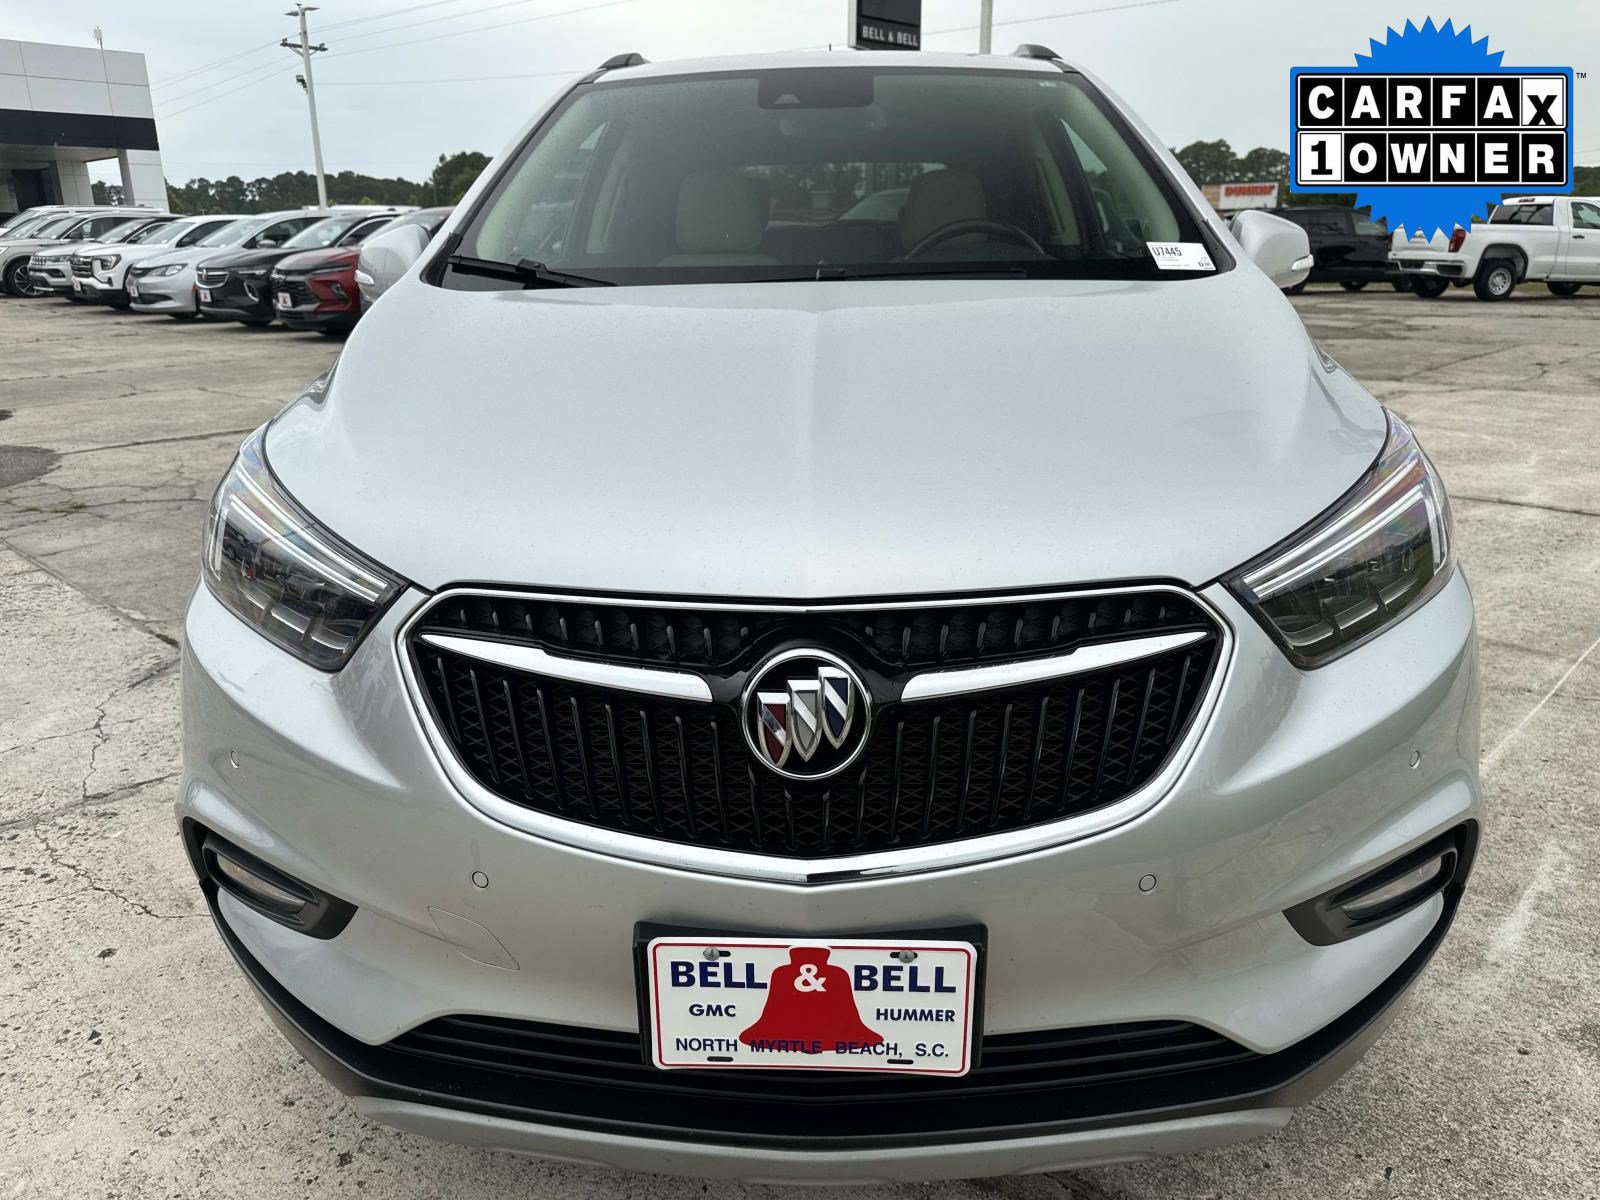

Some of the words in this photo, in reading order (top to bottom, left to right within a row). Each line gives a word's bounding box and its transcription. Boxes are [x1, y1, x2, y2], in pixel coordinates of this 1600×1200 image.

[862, 25, 884, 40] BELL
[896, 31, 918, 46] BELL
[671, 961, 768, 989] BELL
[794, 963, 827, 993] &
[853, 965, 956, 993] BELL
[689, 1004, 736, 1017] GMC
[876, 1008, 955, 1022] HUMMER
[676, 1037, 738, 1052] NORTH
[750, 1039, 823, 1054] MYRTLE
[835, 1041, 902, 1058] BEACH,
[915, 1043, 949, 1058] S.C.
